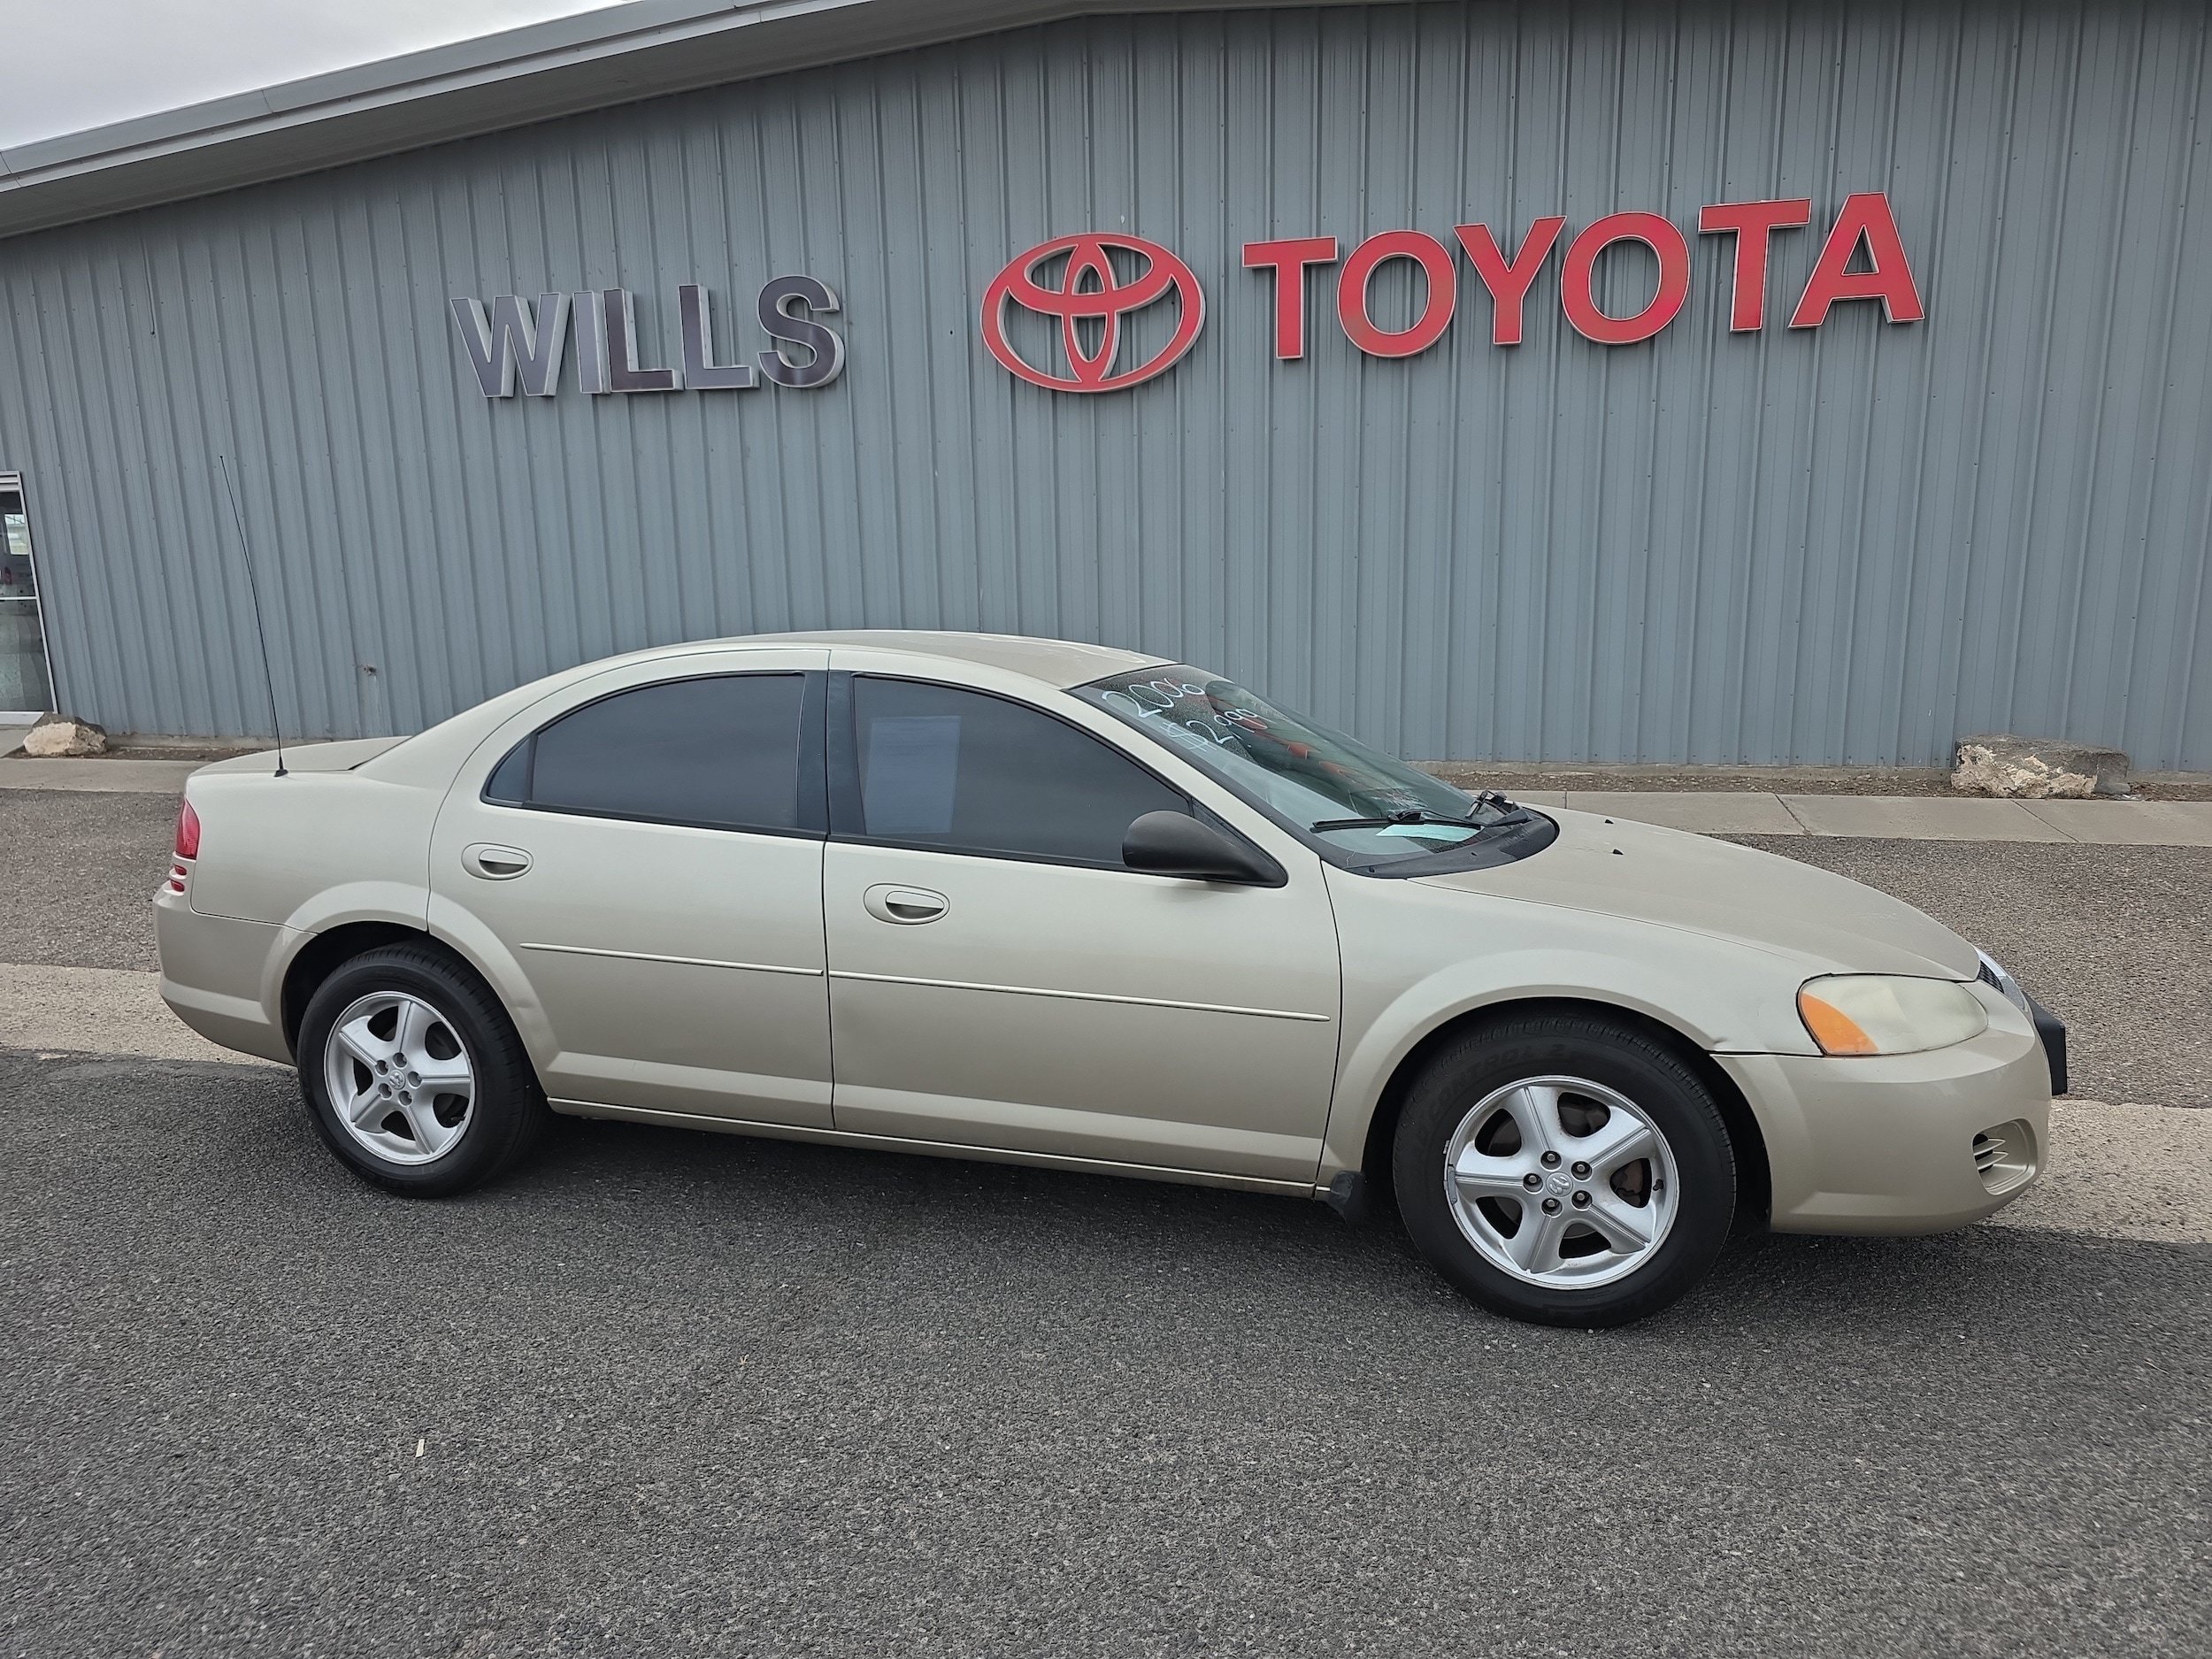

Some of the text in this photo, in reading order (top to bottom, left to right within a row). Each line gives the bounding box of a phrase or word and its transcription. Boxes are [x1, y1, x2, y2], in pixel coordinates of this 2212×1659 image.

[449, 191, 1925, 398] WILLS TOYOTA
[1102, 678, 1206, 718] 2006
